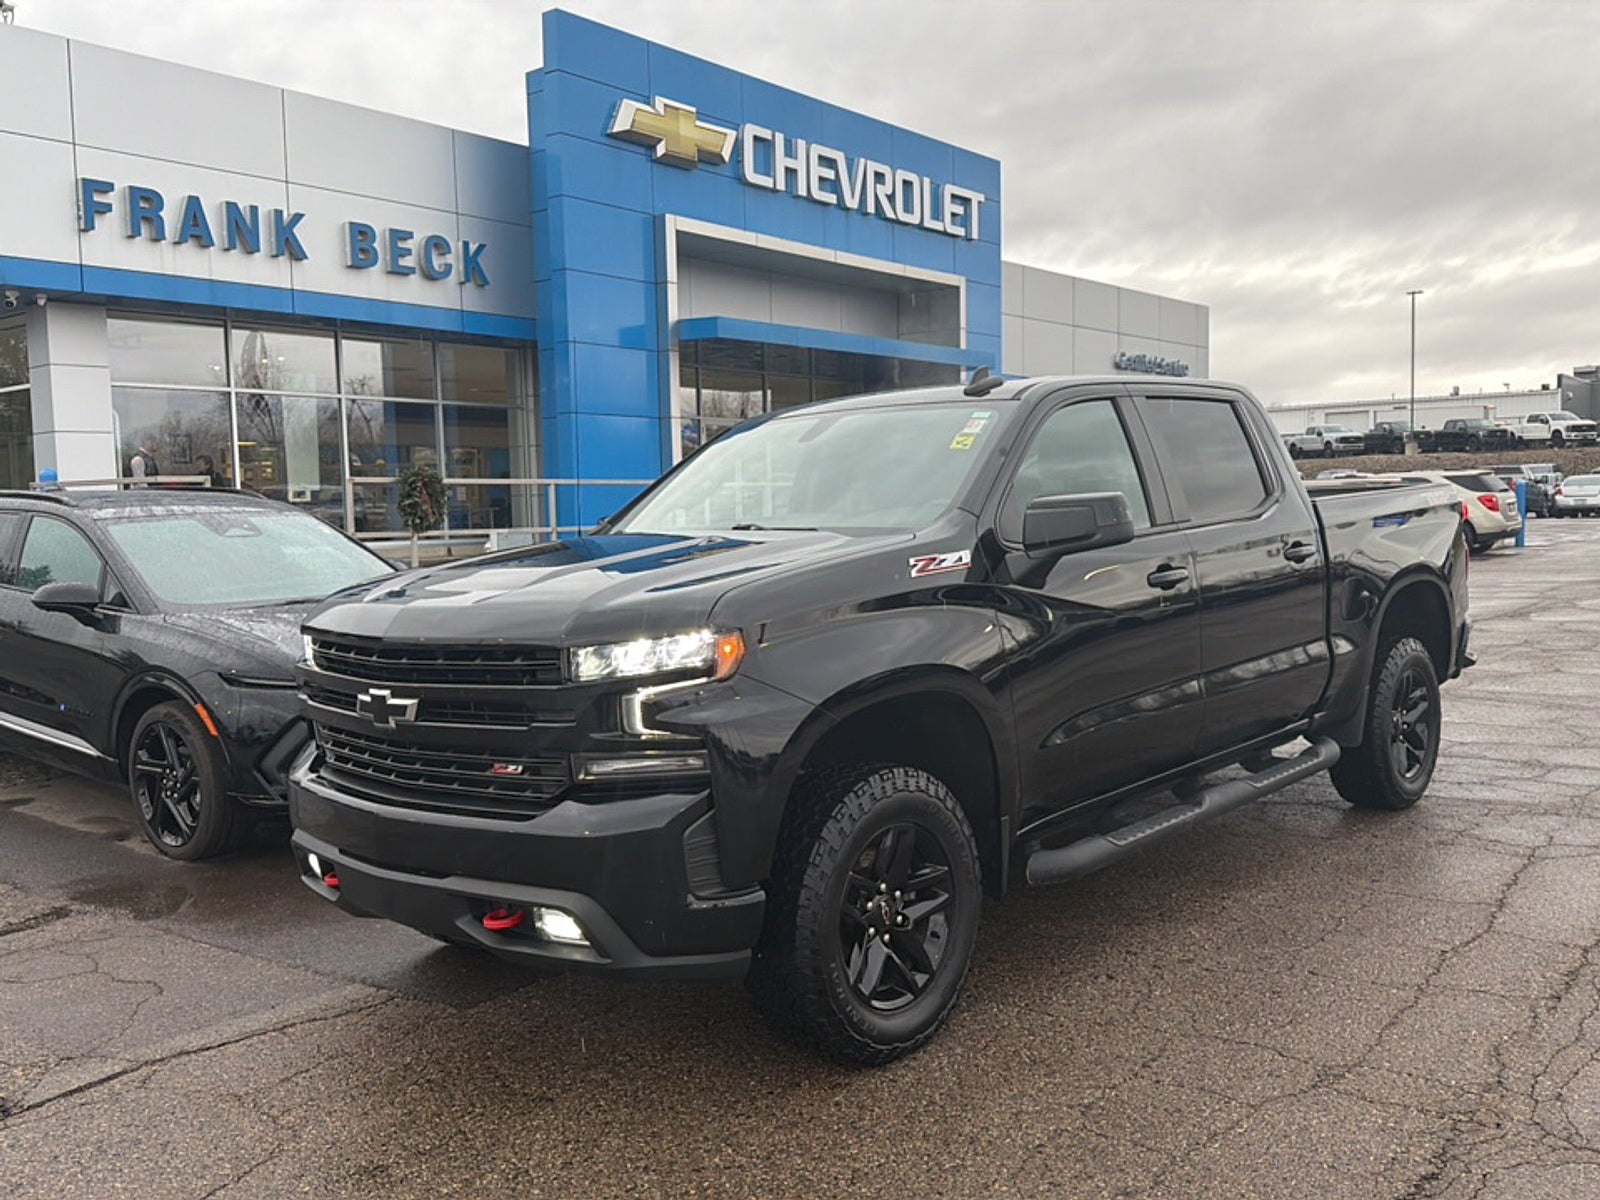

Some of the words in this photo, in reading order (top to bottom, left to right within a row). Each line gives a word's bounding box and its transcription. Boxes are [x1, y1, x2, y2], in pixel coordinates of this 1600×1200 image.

[78, 176, 309, 261] FRANK
[344, 221, 491, 287] BECK
[740, 122, 985, 240] CHEVROLET
[908, 549, 972, 578] Z71
